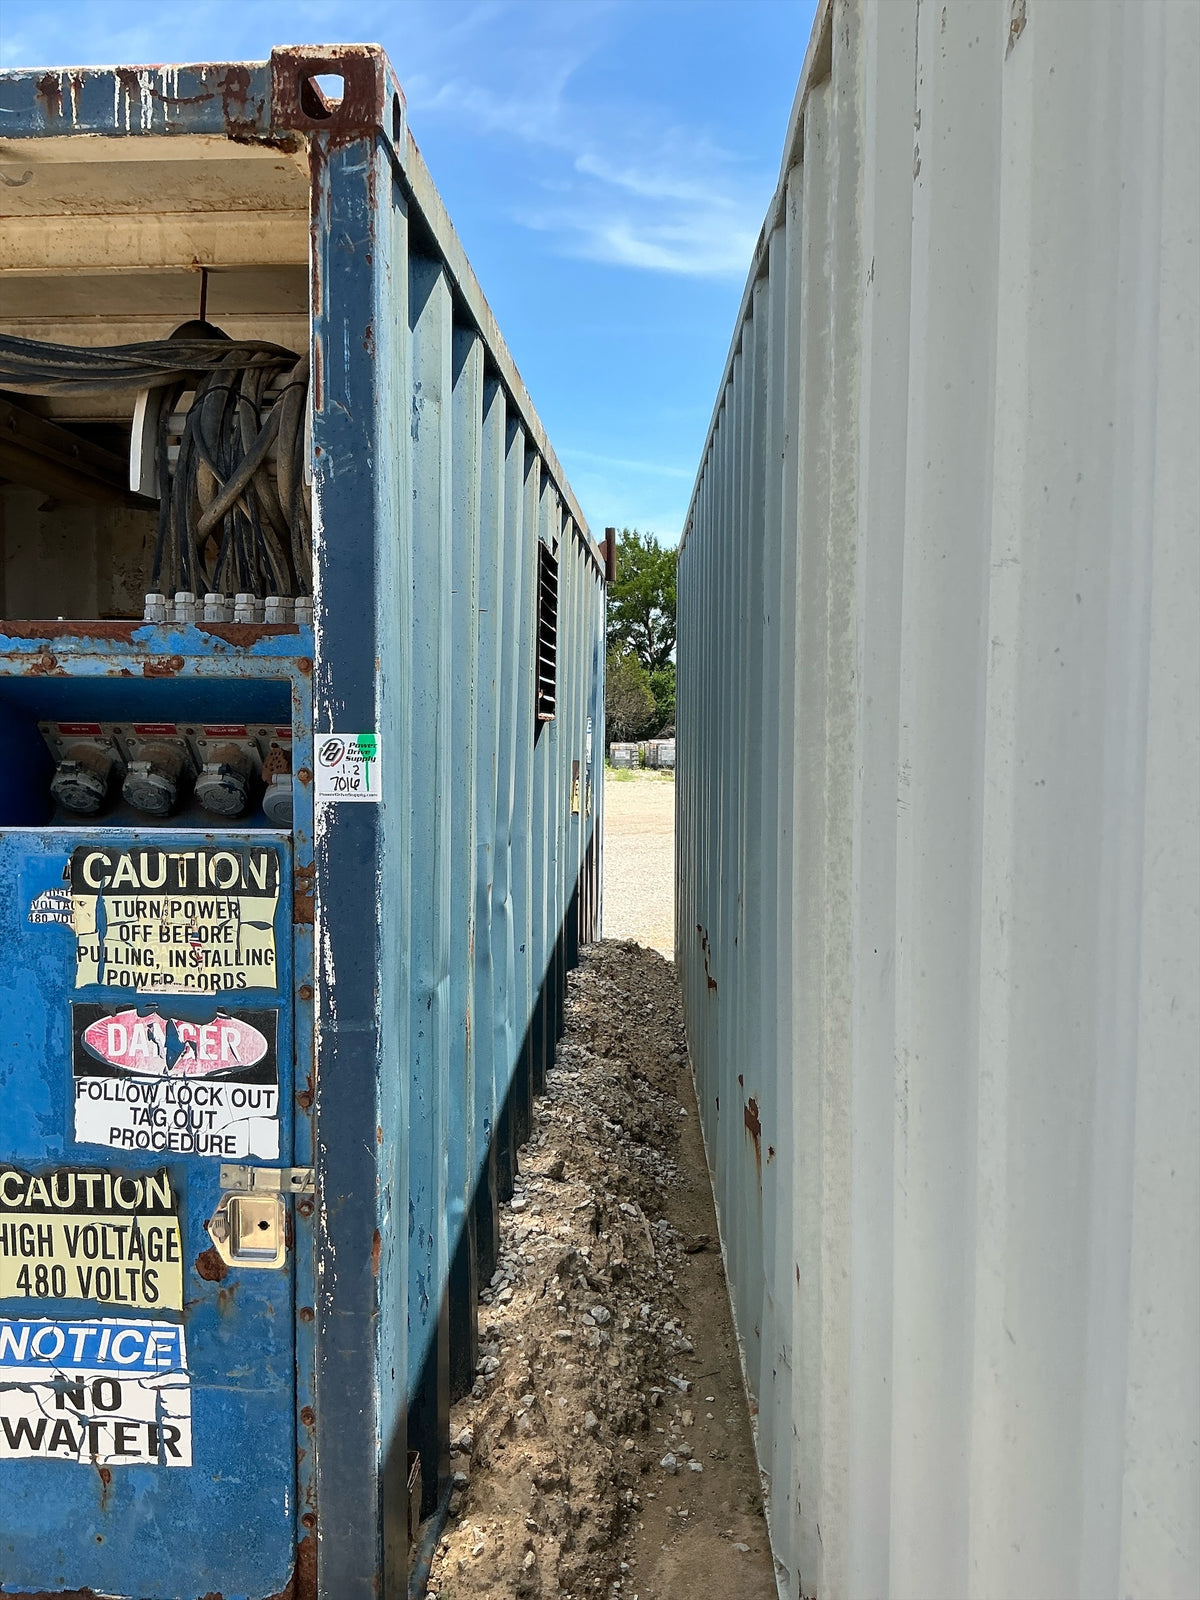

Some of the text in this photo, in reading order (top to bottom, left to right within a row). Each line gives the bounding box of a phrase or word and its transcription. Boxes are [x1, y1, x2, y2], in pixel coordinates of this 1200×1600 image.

[82, 852, 267, 889] CAUTION
[112, 900, 239, 920] TURN POWER
[119, 924, 234, 944] OFF BEFORE
[77, 945, 275, 969] PULLING, INSTALLING
[107, 970, 247, 991] POWER CORDS
[76, 1081, 275, 1109] FOLLOW LOCK OUT
[130, 1106, 217, 1130] TAG OUT
[109, 1127, 237, 1154] PROCEDURE
[0, 1171, 172, 1210] CAUTION
[0, 1223, 180, 1262] HIGH VOLTAGE
[16, 1263, 160, 1303] 480 VOLTS
[0, 1326, 176, 1366] NOTICE
[54, 1375, 122, 1411] NO
[0, 1416, 183, 1458] WATER
